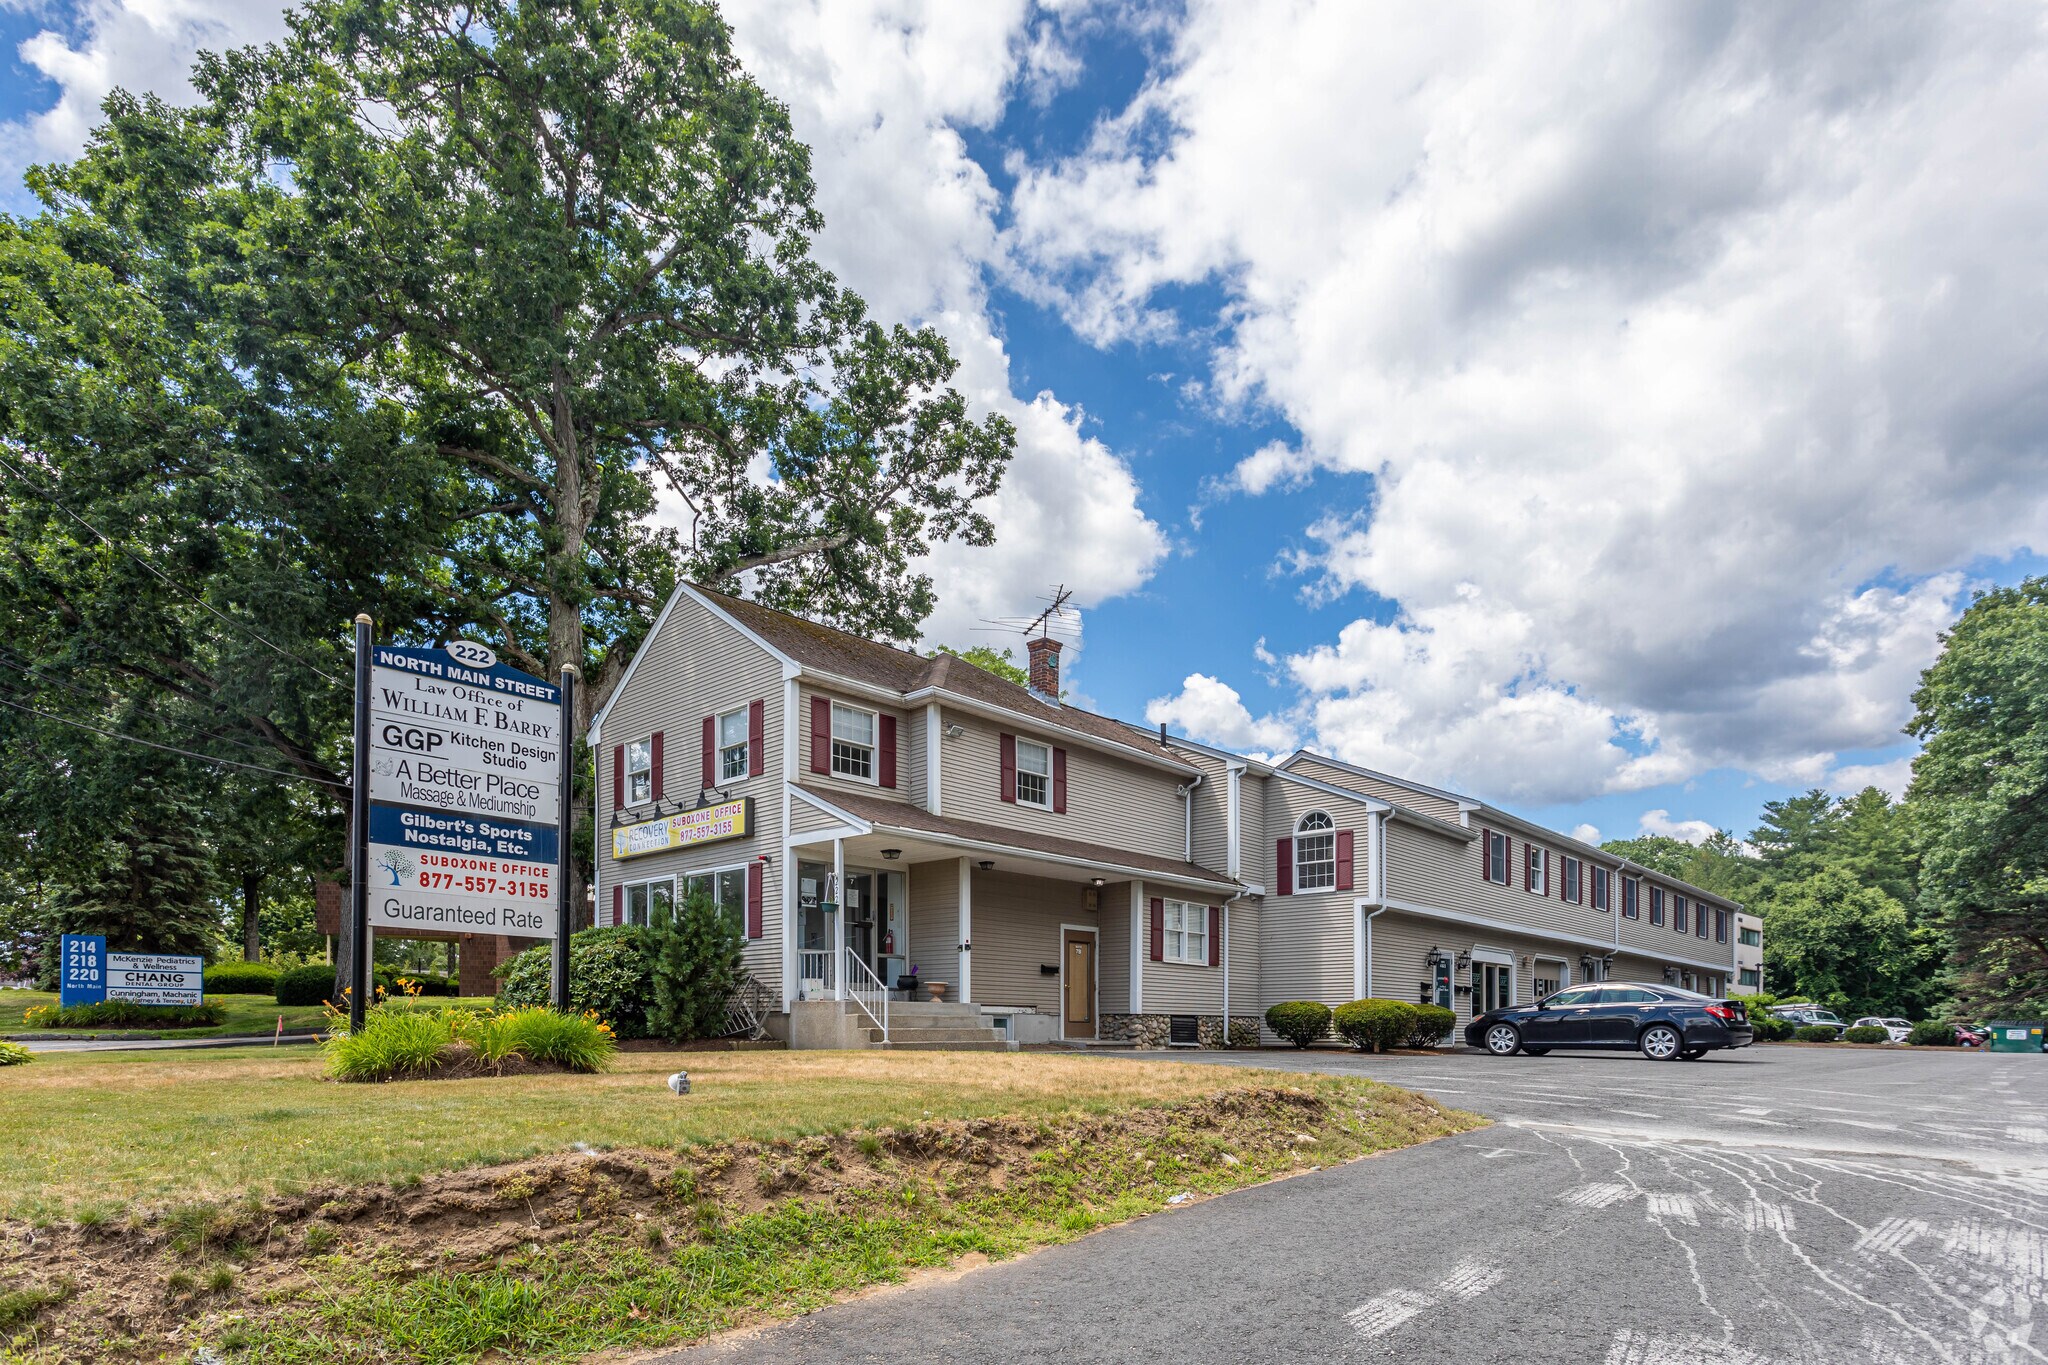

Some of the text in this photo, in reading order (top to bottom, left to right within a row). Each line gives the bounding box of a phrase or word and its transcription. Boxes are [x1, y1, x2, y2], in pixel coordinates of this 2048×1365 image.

[455, 644, 490, 664] 222
[380, 651, 555, 700] NORTH MAIN STREET
[415, 677, 524, 712] Law Office of
[380, 688, 552, 738] WILLIAM F. BARRY
[382, 724, 443, 752] GGP
[450, 731, 556, 762] Kitchen Design
[483, 752, 527, 770] Studio
[396, 759, 540, 800] A Better Place
[400, 781, 536, 819] Massage & Mediumship
[400, 812, 532, 841] Gilbert's Sports
[672, 803, 742, 828] SUBOXONE OFFICE
[404, 828, 529, 855] Nostalgia, Etc.
[628, 821, 669, 842] RECOVERY
[680, 820, 732, 842] 877-557-3155
[629, 836, 670, 852] CONNECTION
[420, 854, 549, 878] SUBOXONE OFFICE
[420, 872, 549, 898] 877-557-3155
[384, 898, 543, 929] Guaranteed Rate
[70, 940, 96, 953] 214
[70, 954, 97, 967] 218
[112, 956, 153, 964] McKenzie
[70, 968, 99, 981] 220
[125, 972, 184, 982] CHANG
[110, 990, 160, 998] Cunningham,
